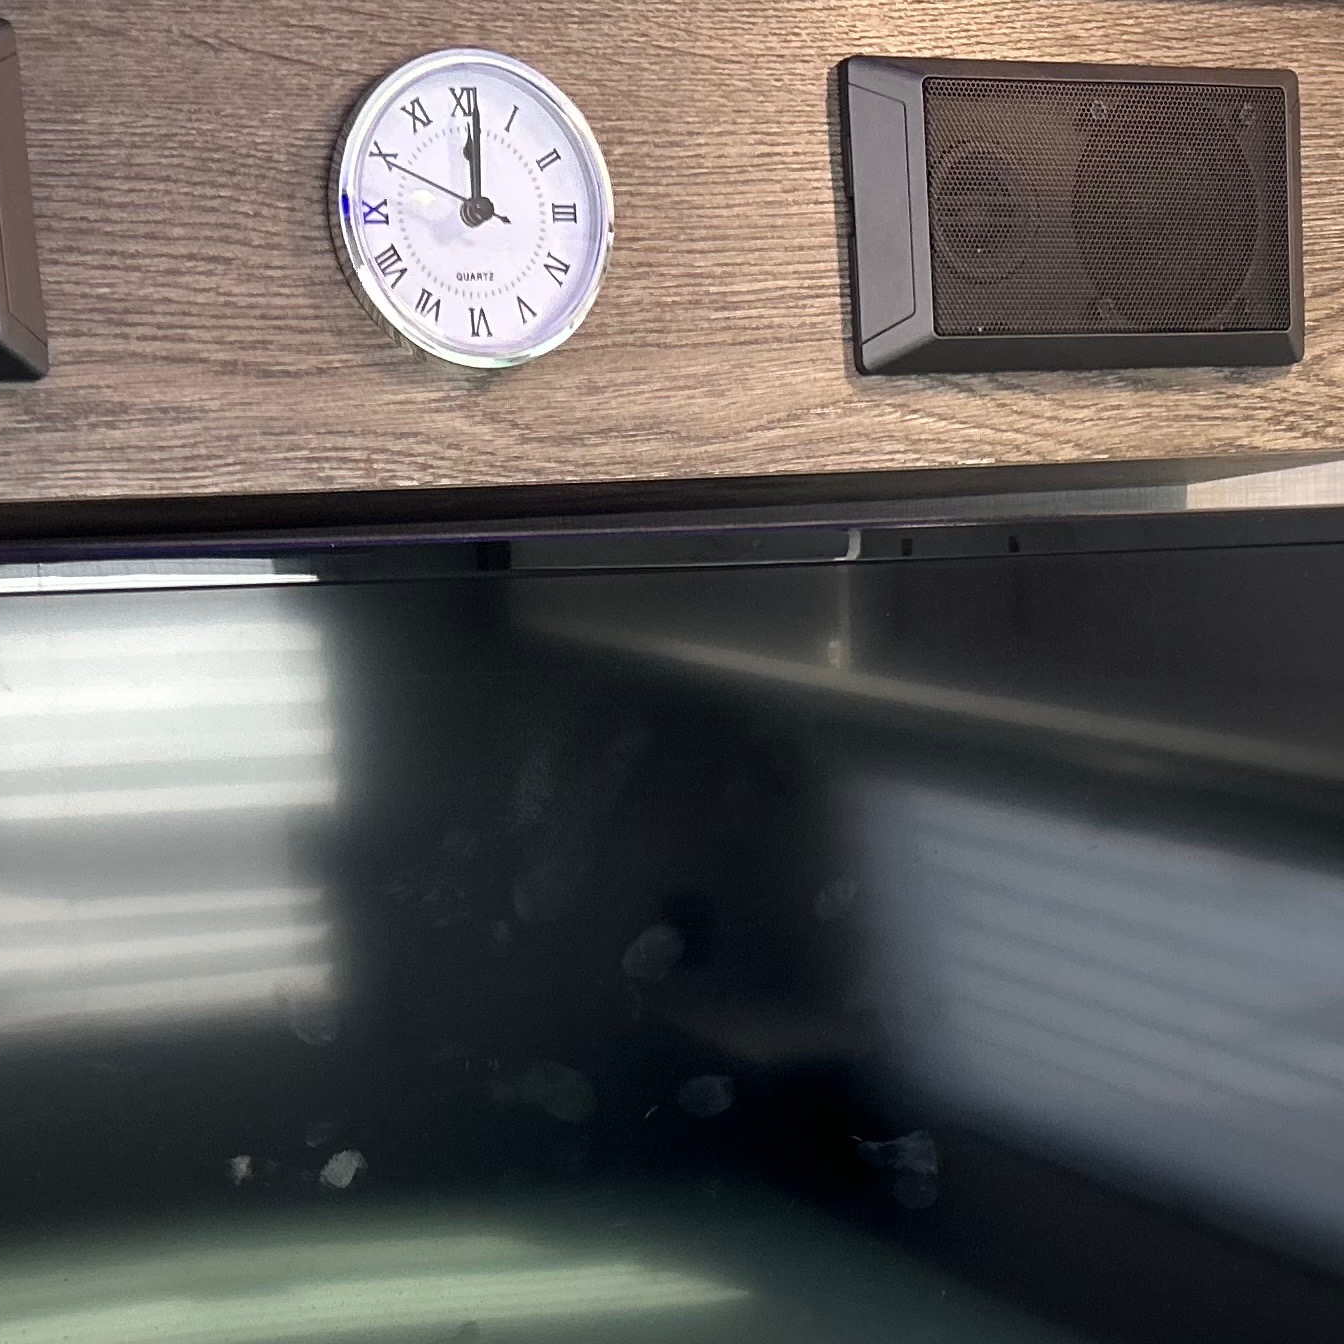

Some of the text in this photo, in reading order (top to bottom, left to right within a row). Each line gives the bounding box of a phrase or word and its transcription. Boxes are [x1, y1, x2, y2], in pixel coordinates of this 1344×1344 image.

[400, 97, 433, 133] XI
[369, 140, 399, 171] X
[536, 148, 561, 172] II
[362, 198, 389, 225] IX
[551, 203, 577, 224] III
[374, 243, 408, 289] VIII
[455, 271, 494, 282] QUARTZ
[543, 252, 571, 287] IV
[415, 288, 441, 323] VII
[516, 295, 537, 324] V
[468, 307, 493, 337] VI
